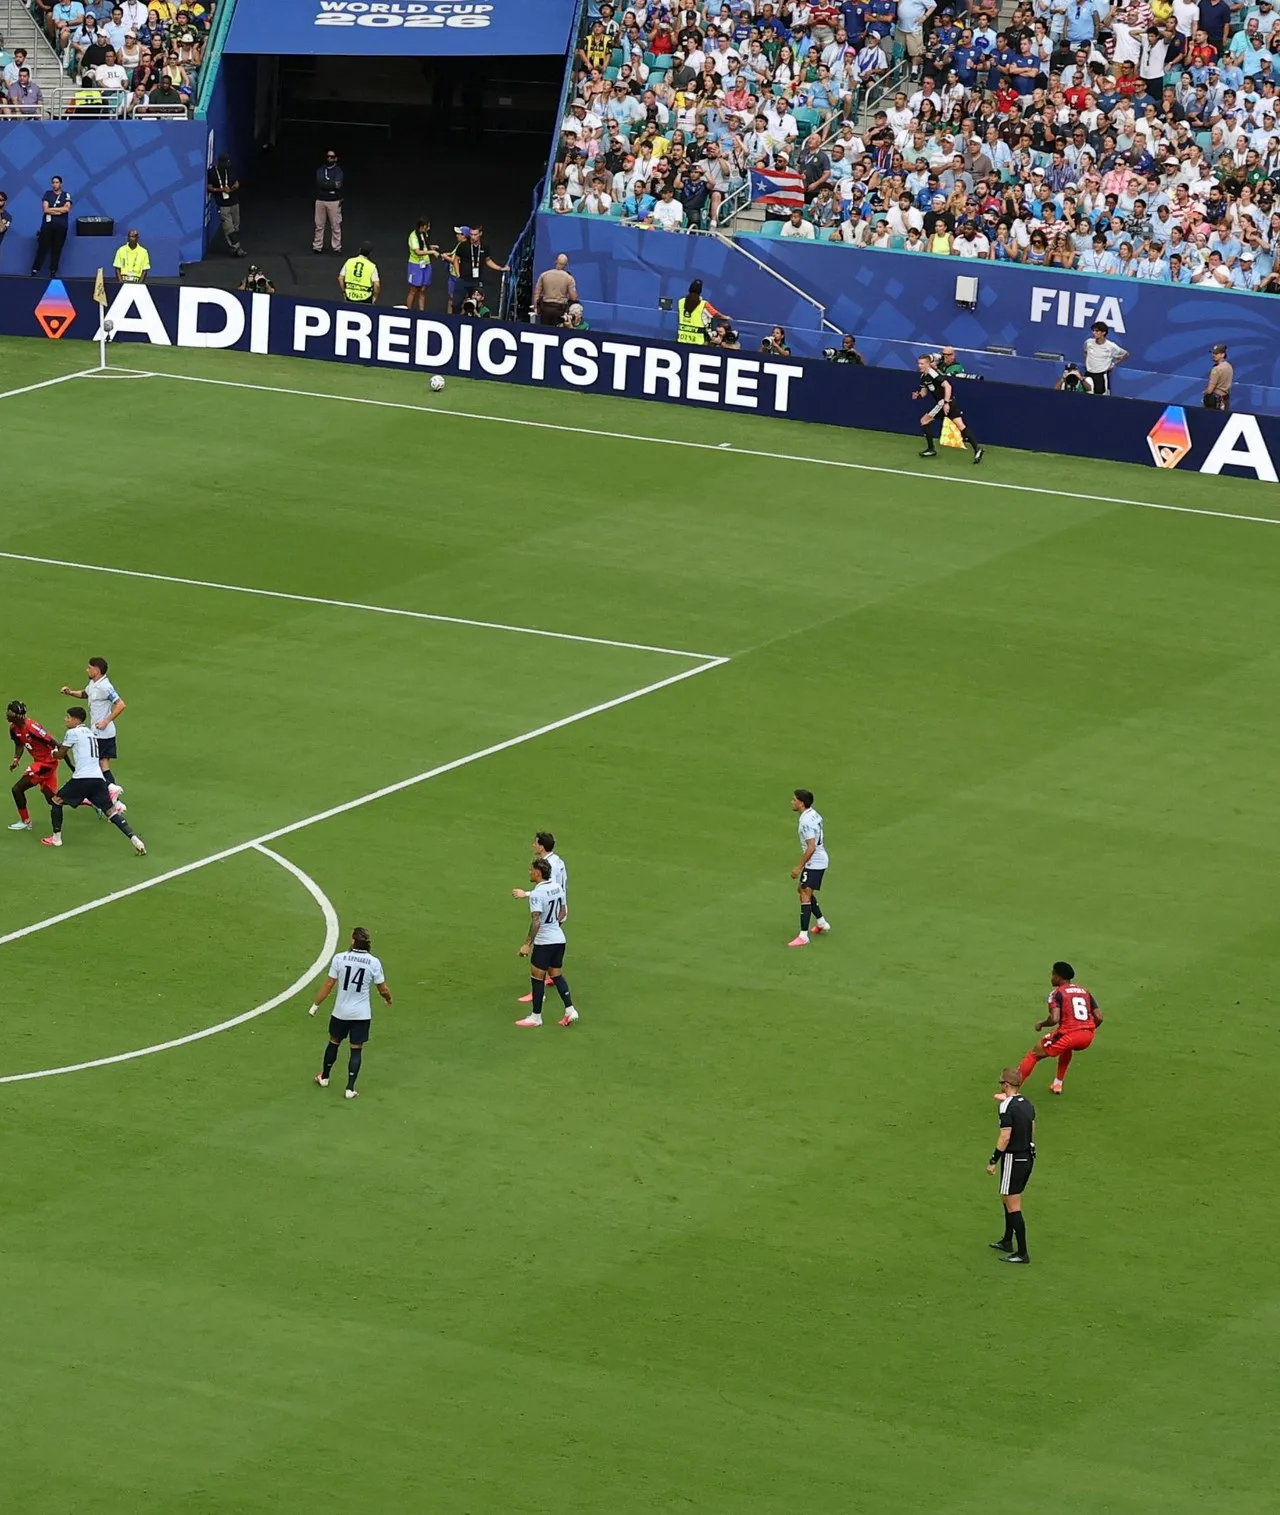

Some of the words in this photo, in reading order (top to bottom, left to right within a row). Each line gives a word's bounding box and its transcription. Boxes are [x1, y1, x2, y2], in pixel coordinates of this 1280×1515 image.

[314, 12, 491, 28] 2026
[321, 2, 428, 14] WORLD
[434, 4, 494, 14] CUP
[1030, 286, 1126, 334] FIFA
[92, 283, 271, 361] ADI
[293, 305, 803, 412] PREDICTSTREET
[342, 964, 366, 993] 14
[1071, 996, 1089, 1021] 6
